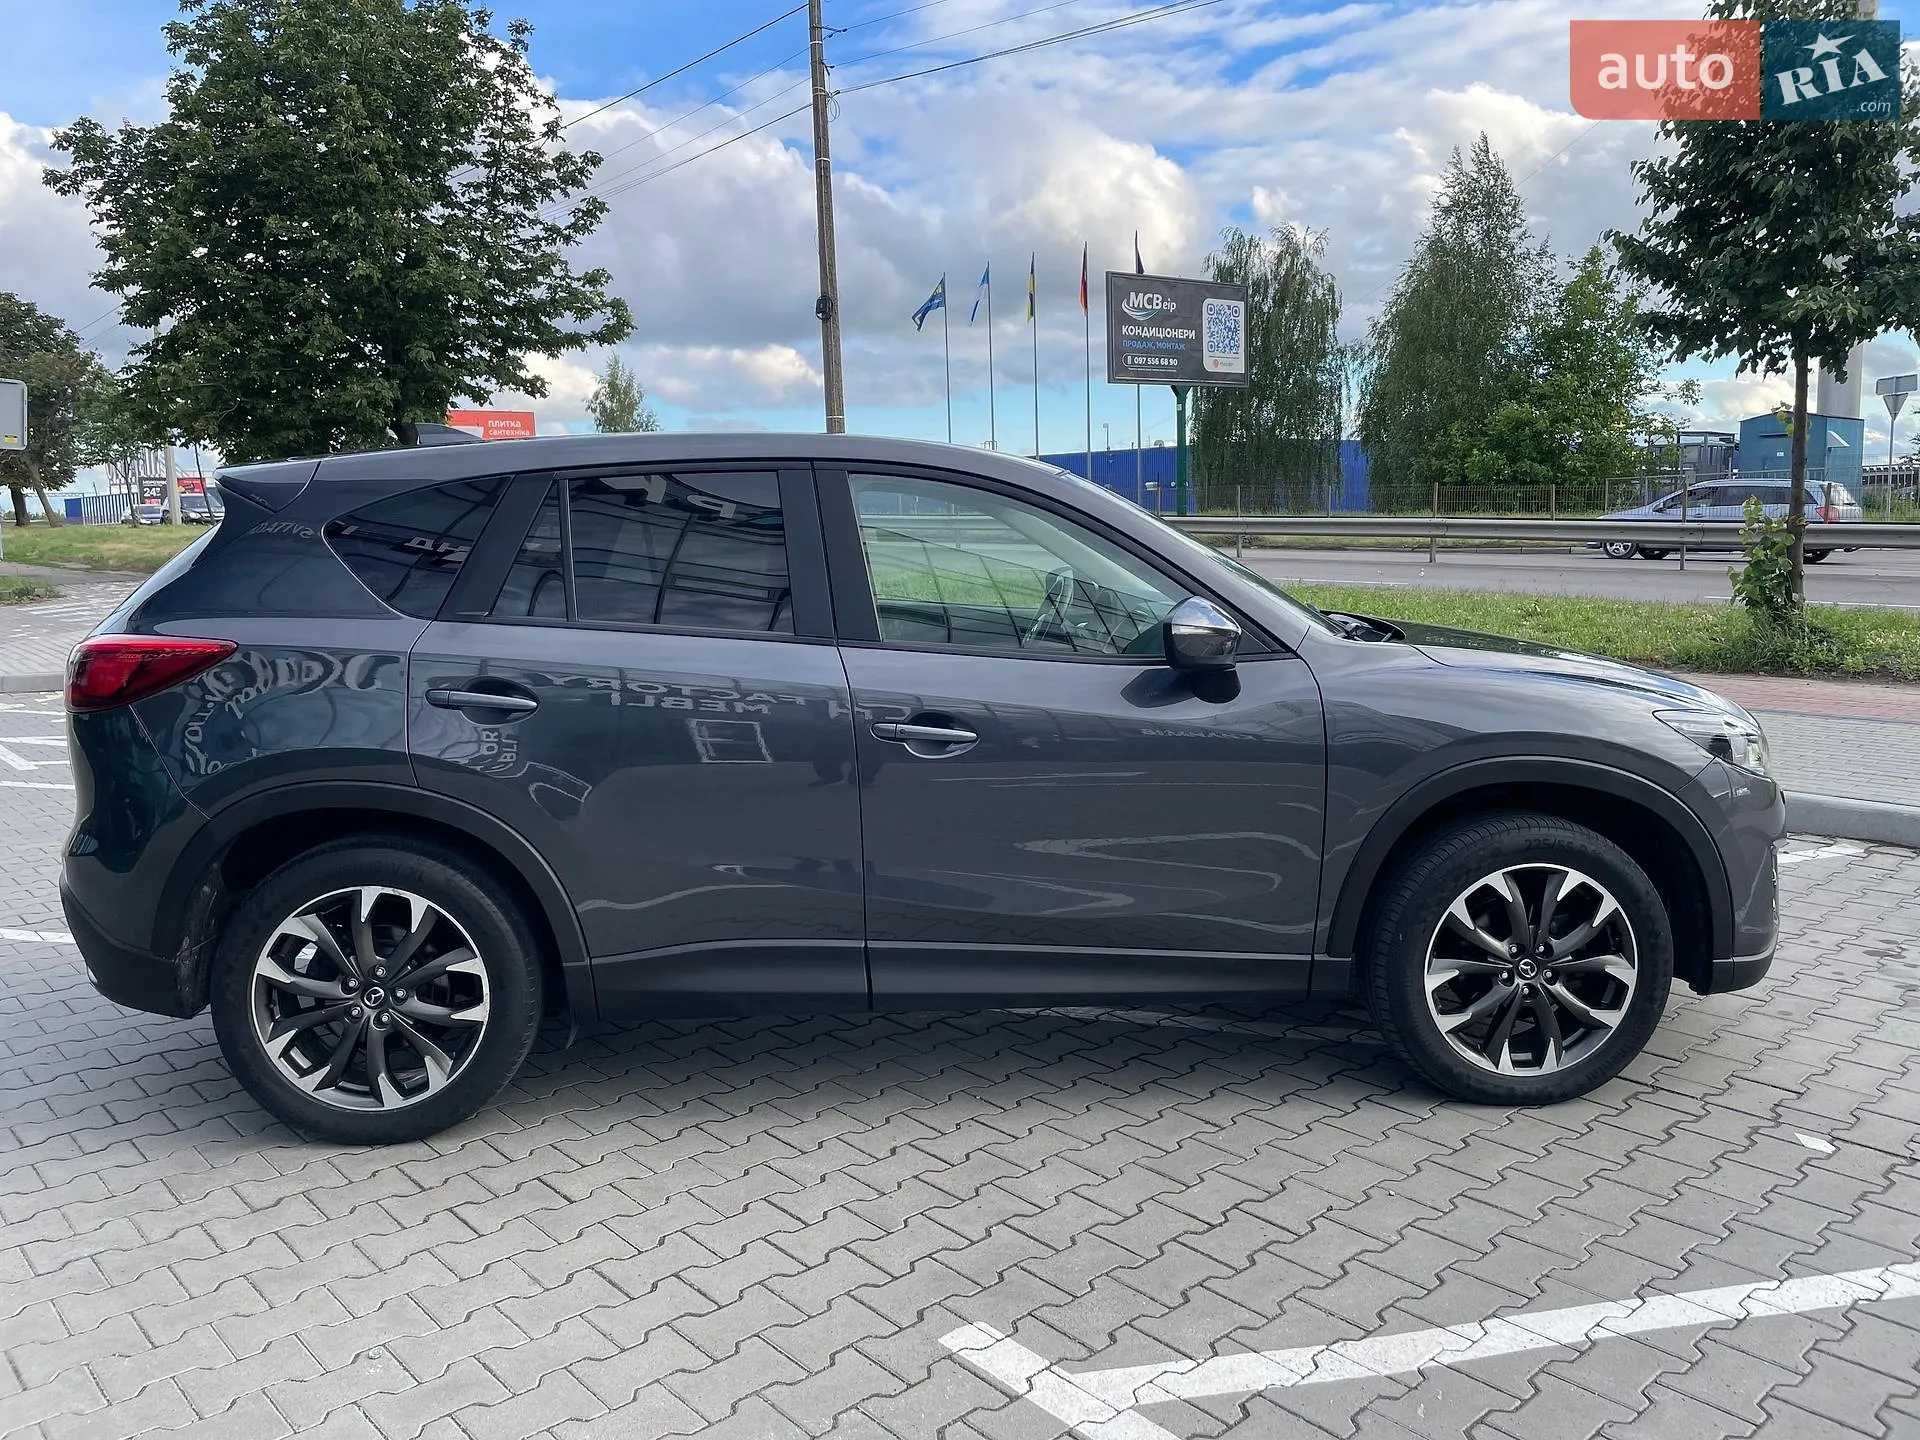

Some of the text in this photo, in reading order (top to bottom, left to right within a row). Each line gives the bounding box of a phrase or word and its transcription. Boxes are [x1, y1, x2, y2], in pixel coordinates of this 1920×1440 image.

[1122, 325, 1196, 339] КОНДИЦІОНЕРИ
[1134, 356, 1146, 364] 097
[488, 420, 521, 428] плитка
